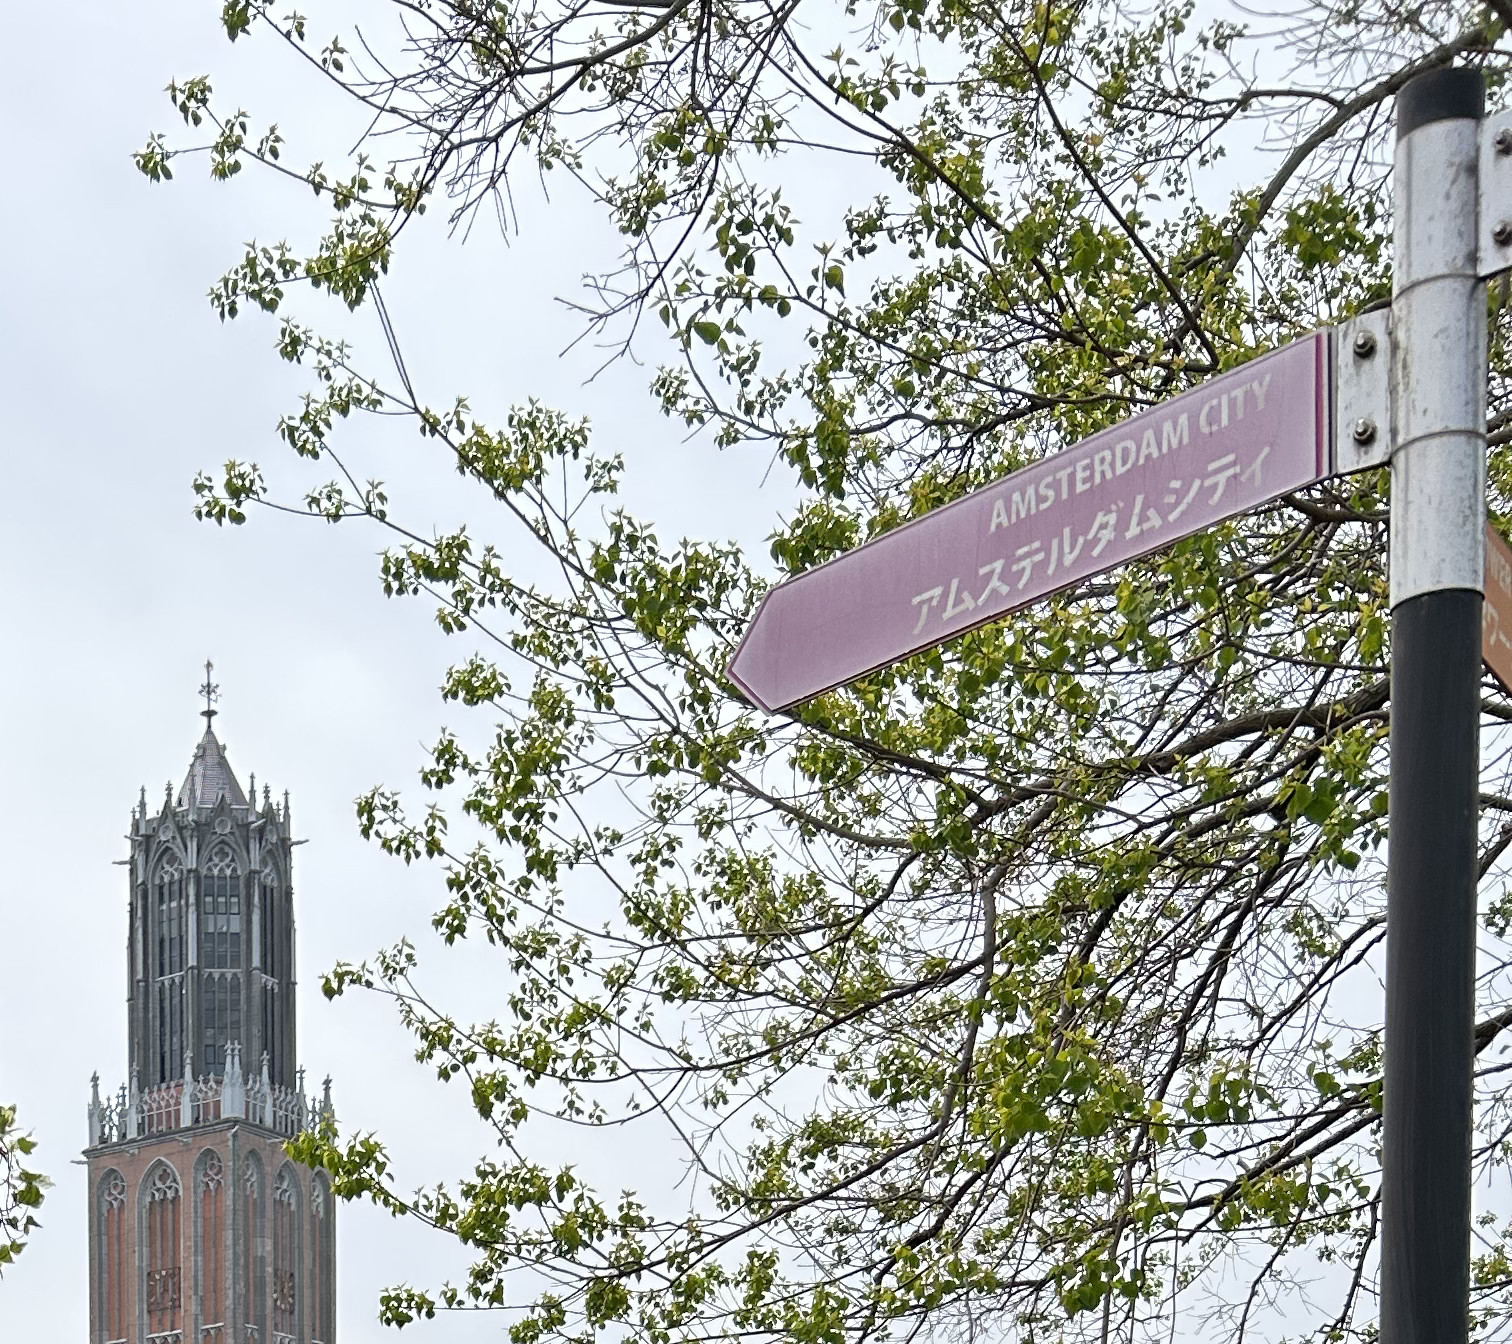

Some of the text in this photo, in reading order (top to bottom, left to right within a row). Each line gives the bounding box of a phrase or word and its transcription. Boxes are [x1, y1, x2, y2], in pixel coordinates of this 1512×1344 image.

[911, 446, 1272, 635] アムステルダムシティ
[989, 374, 1272, 535] AMSTERDAM CITY
